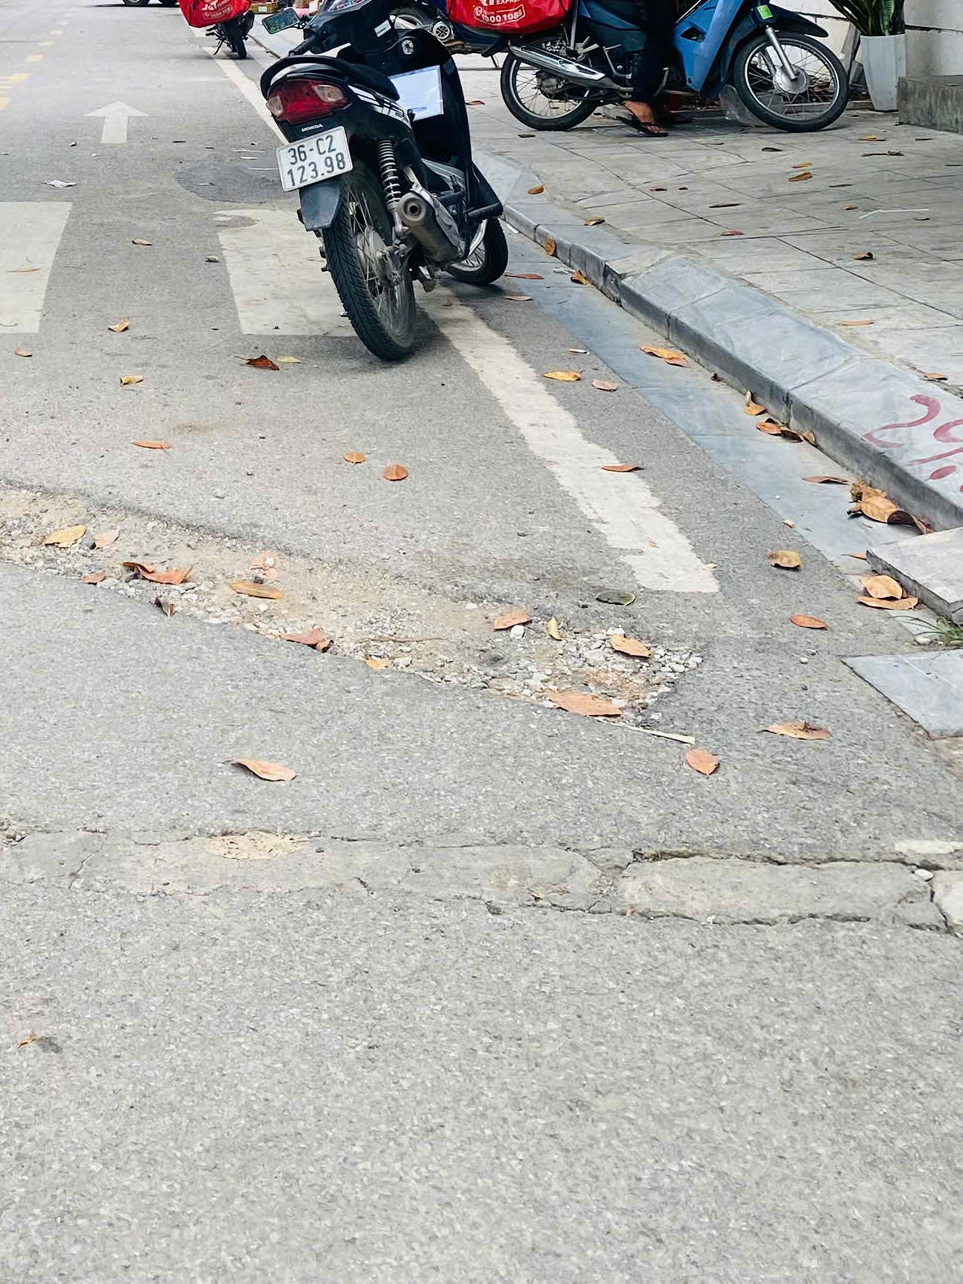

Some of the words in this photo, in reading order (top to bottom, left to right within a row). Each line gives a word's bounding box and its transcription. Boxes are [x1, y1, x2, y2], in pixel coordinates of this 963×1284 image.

[301, 123, 324, 133] HONDA
[287, 134, 337, 165] 36-C2
[287, 152, 346, 187] 123.98
